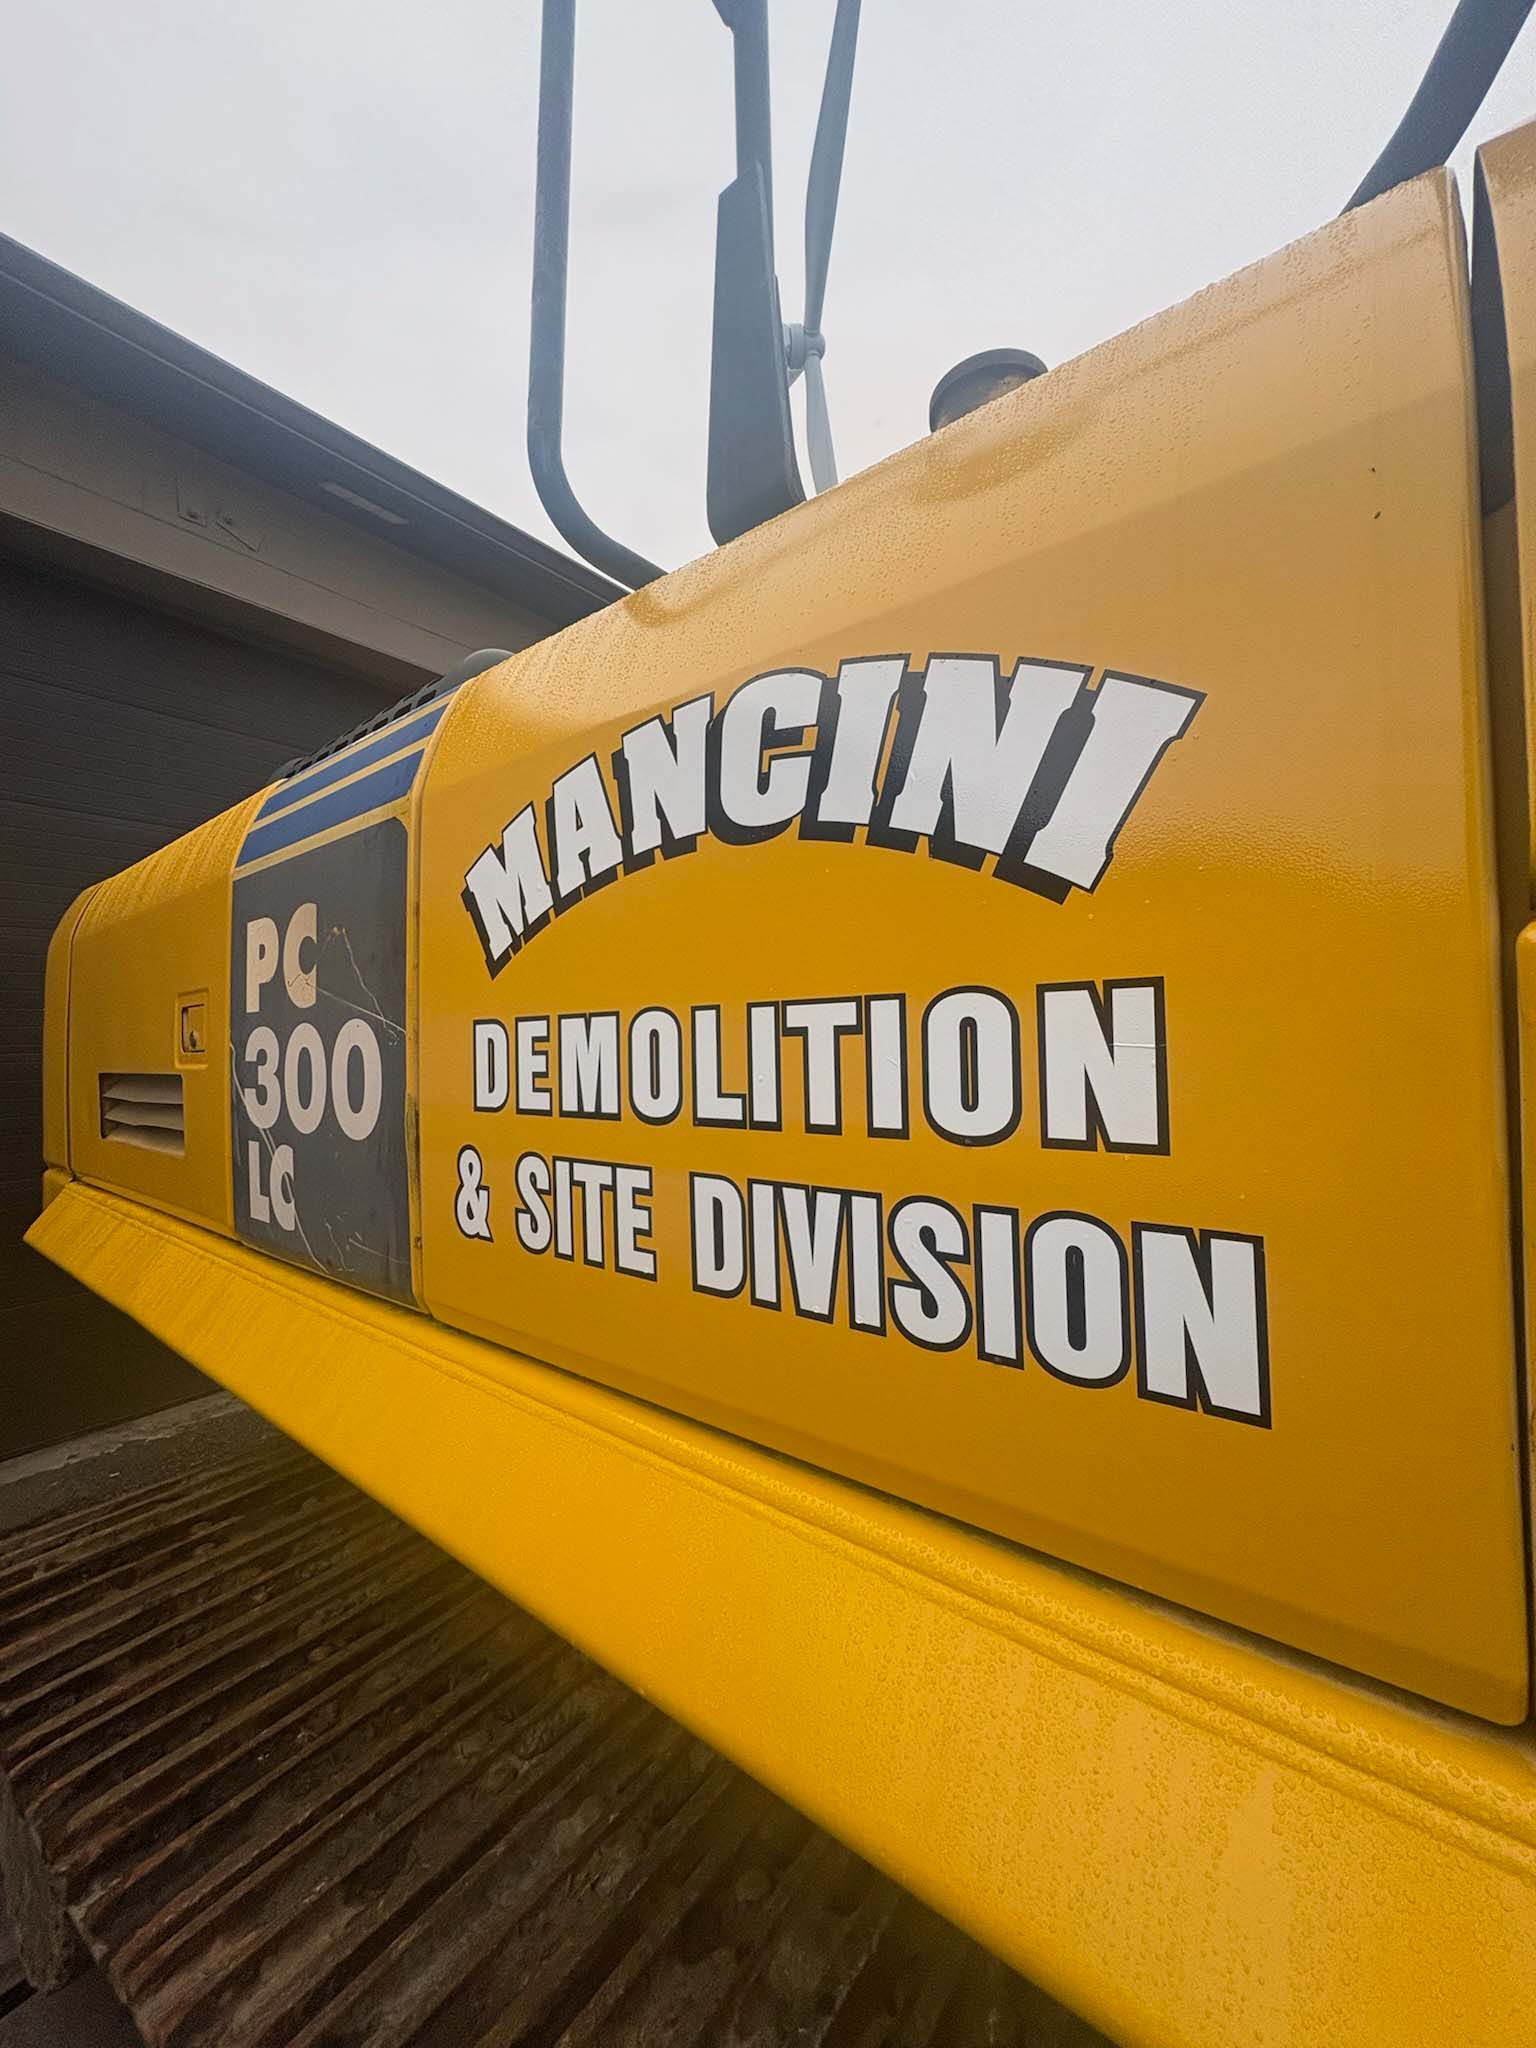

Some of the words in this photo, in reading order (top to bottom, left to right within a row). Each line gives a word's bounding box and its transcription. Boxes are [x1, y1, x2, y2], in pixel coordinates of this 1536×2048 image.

[461, 652, 1207, 979] MANCINI
[246, 903, 317, 1013] PC
[244, 1018, 382, 1140] 300
[473, 976, 1171, 1156] DEMOLITION
[249, 1141, 296, 1232] LC
[455, 1144, 494, 1242] &
[515, 1151, 658, 1282] SITE
[689, 1172, 1272, 1430] DIVISION
